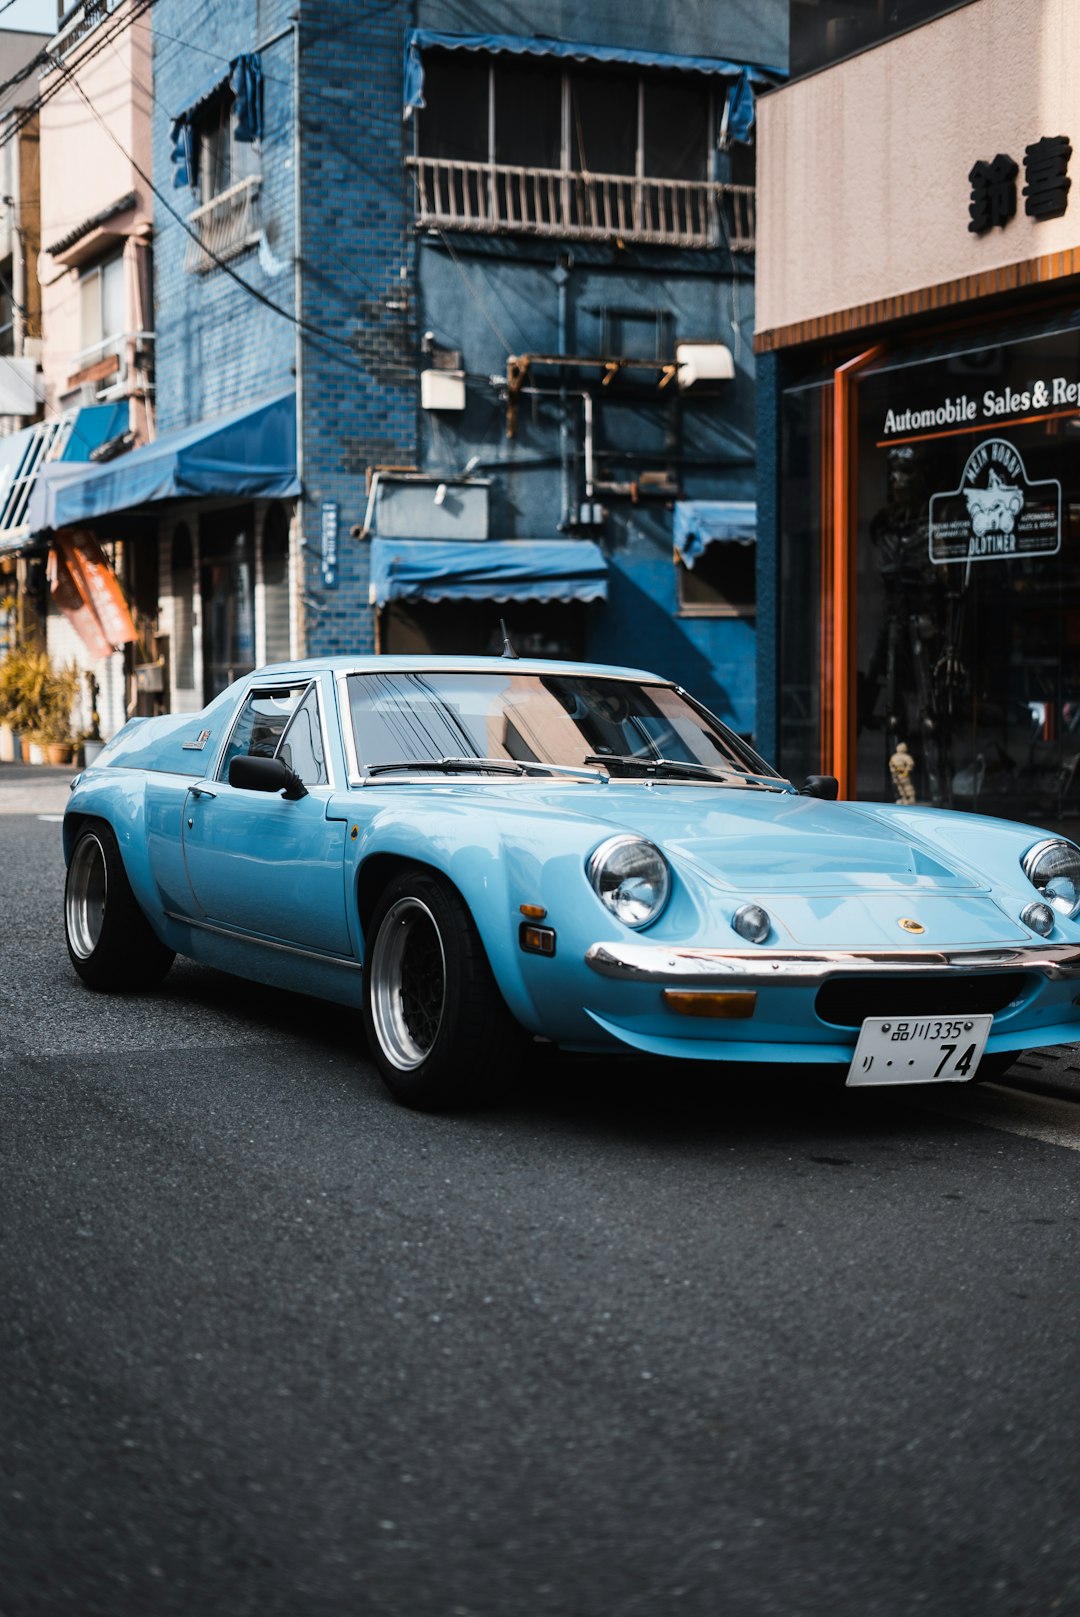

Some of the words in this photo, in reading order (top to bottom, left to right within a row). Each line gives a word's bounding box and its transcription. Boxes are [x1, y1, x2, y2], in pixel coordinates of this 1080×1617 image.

[883, 394, 977, 434] Automobile
[991, 443, 1021, 478] HOBBY
[968, 533, 1016, 555] OLDTIMER
[933, 1043, 977, 1078] 74
